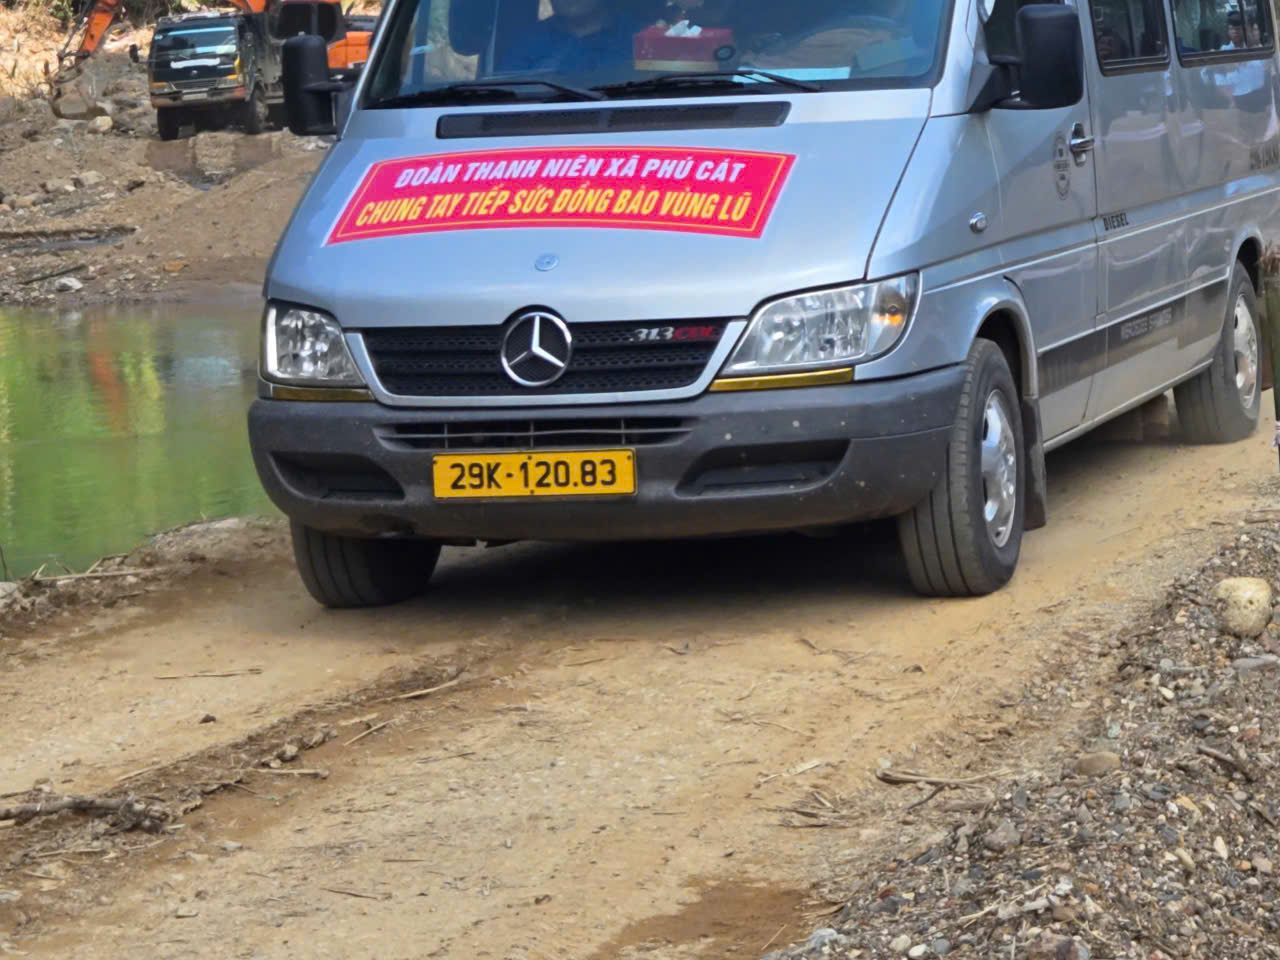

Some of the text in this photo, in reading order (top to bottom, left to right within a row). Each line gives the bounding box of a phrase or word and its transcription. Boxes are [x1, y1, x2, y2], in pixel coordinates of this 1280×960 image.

[394, 155, 747, 189] ĐOÀN THANH NIÊN XÃ PHÚ CÁT
[355, 181, 753, 227] CHUNG TAY TIẾP SỨC ĐỒNG BÀO VÙNG LŨ
[1102, 212, 1130, 231] DIESEL
[449, 458, 617, 490] 29K-120.83
